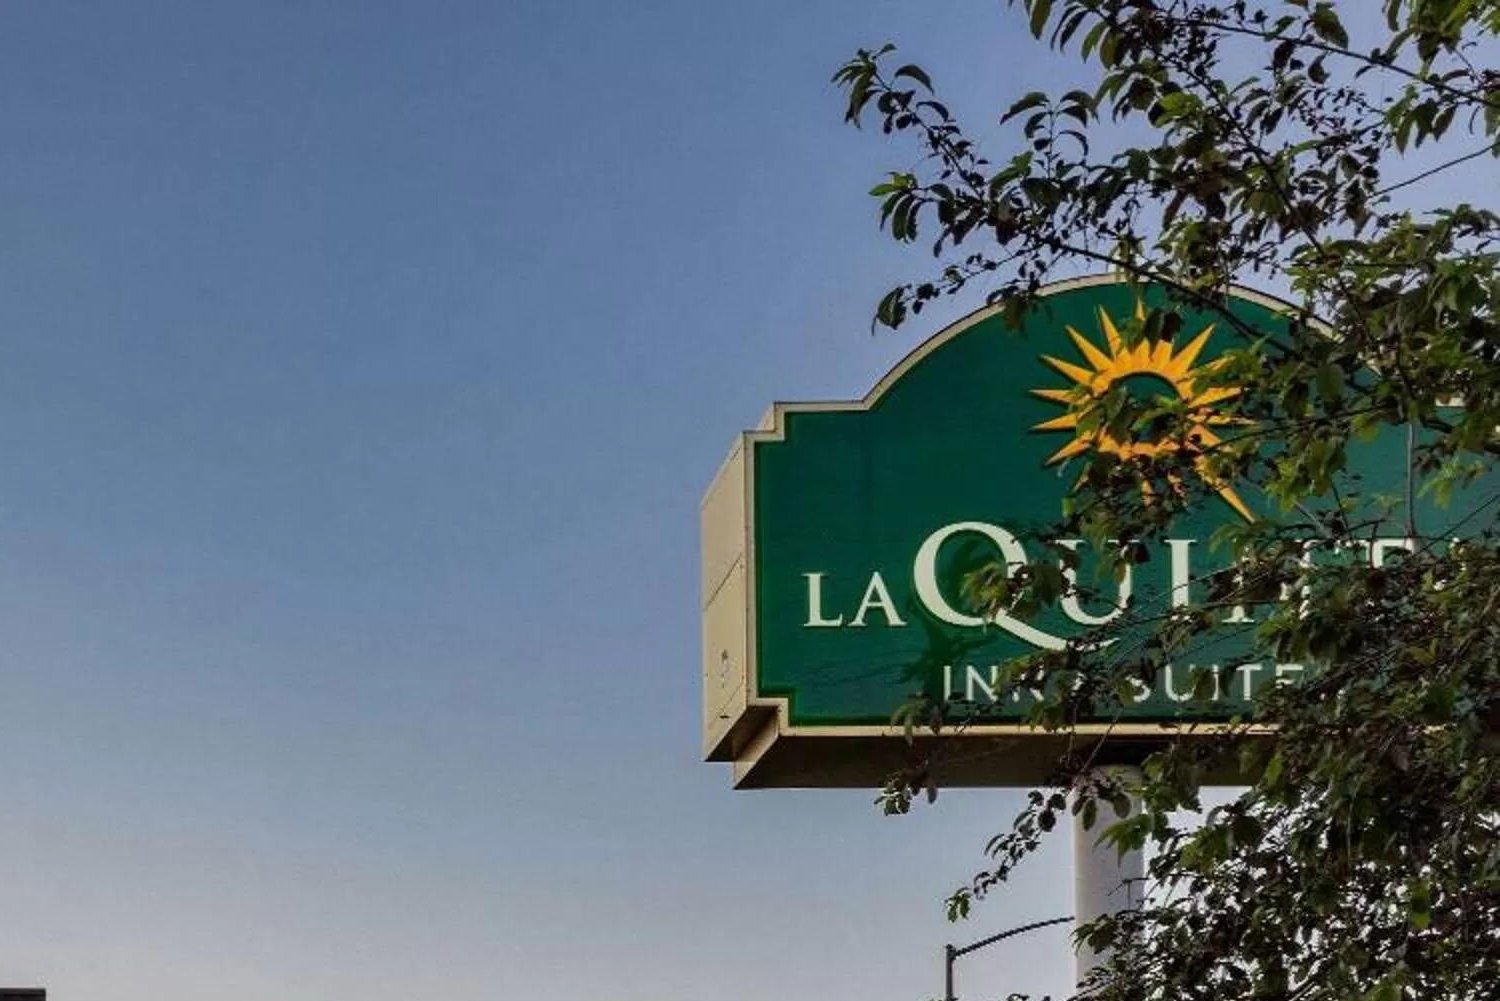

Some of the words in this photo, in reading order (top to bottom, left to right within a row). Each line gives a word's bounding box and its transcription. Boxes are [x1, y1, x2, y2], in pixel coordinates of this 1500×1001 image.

[800, 571, 908, 627] LA
[913, 520, 1462, 652] QUI
[1128, 663, 1332, 703] SUITE
